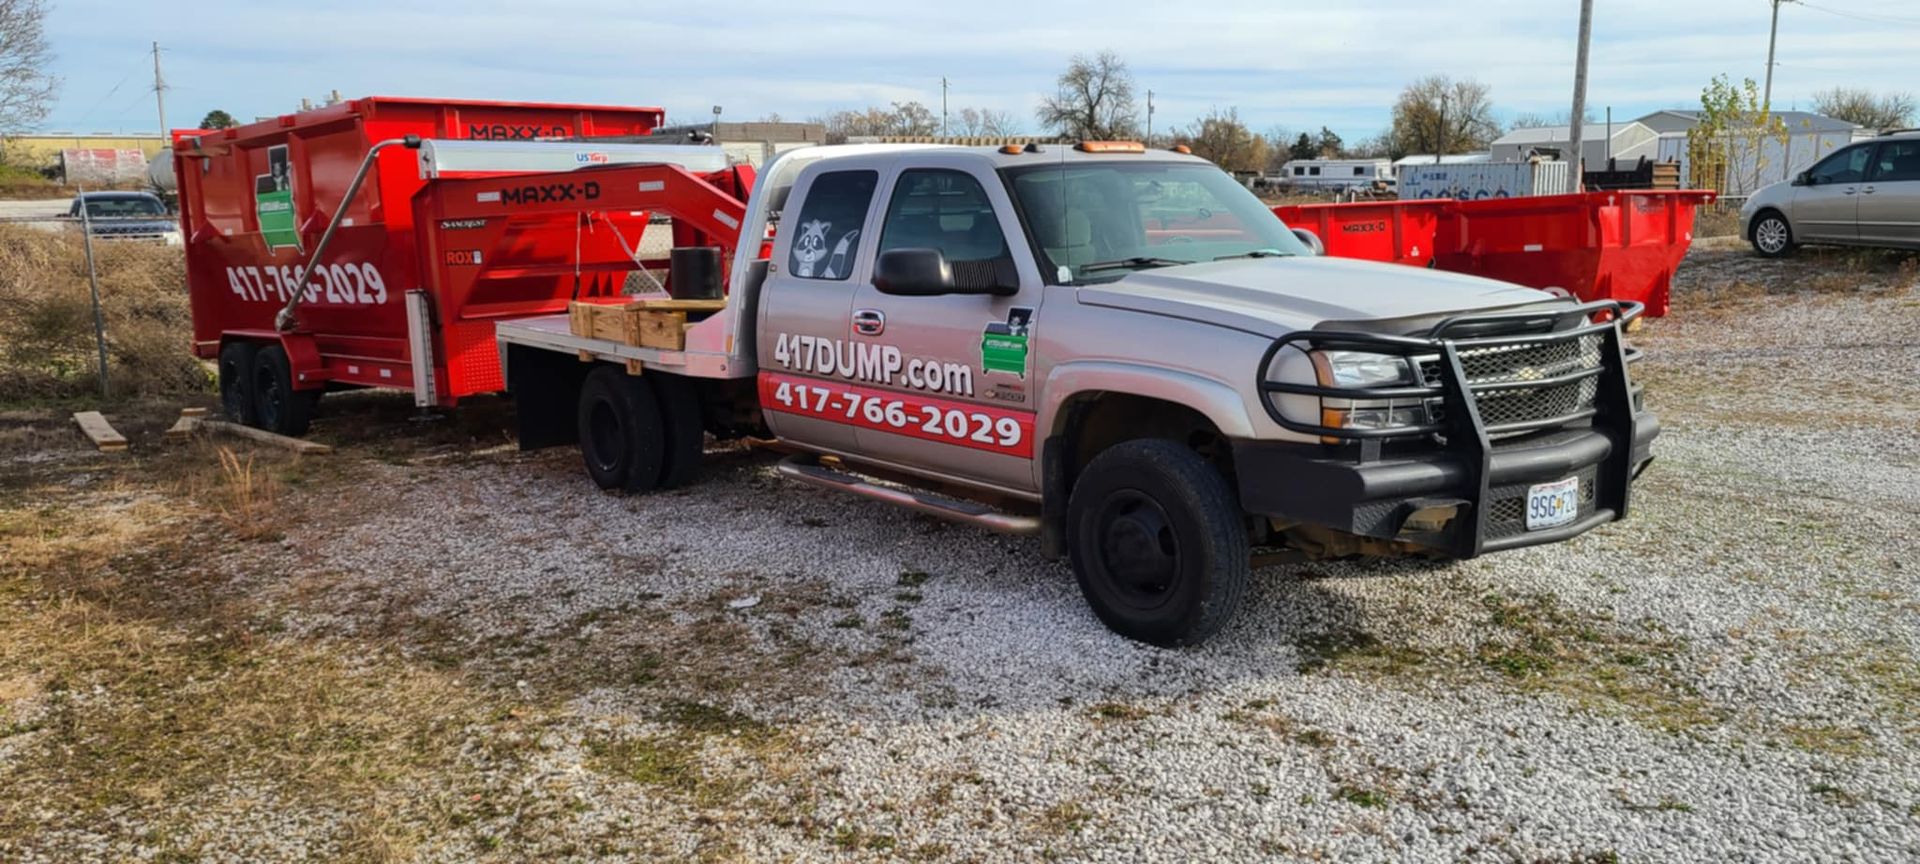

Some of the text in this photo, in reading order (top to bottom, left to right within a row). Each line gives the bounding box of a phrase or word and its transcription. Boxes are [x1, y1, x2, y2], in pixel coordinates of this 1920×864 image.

[502, 181, 600, 206] MAXX-D
[1342, 221, 1385, 232] MAXX-D
[774, 332, 974, 397] 417DUMP.com
[774, 382, 1022, 447] 417-766-2029
